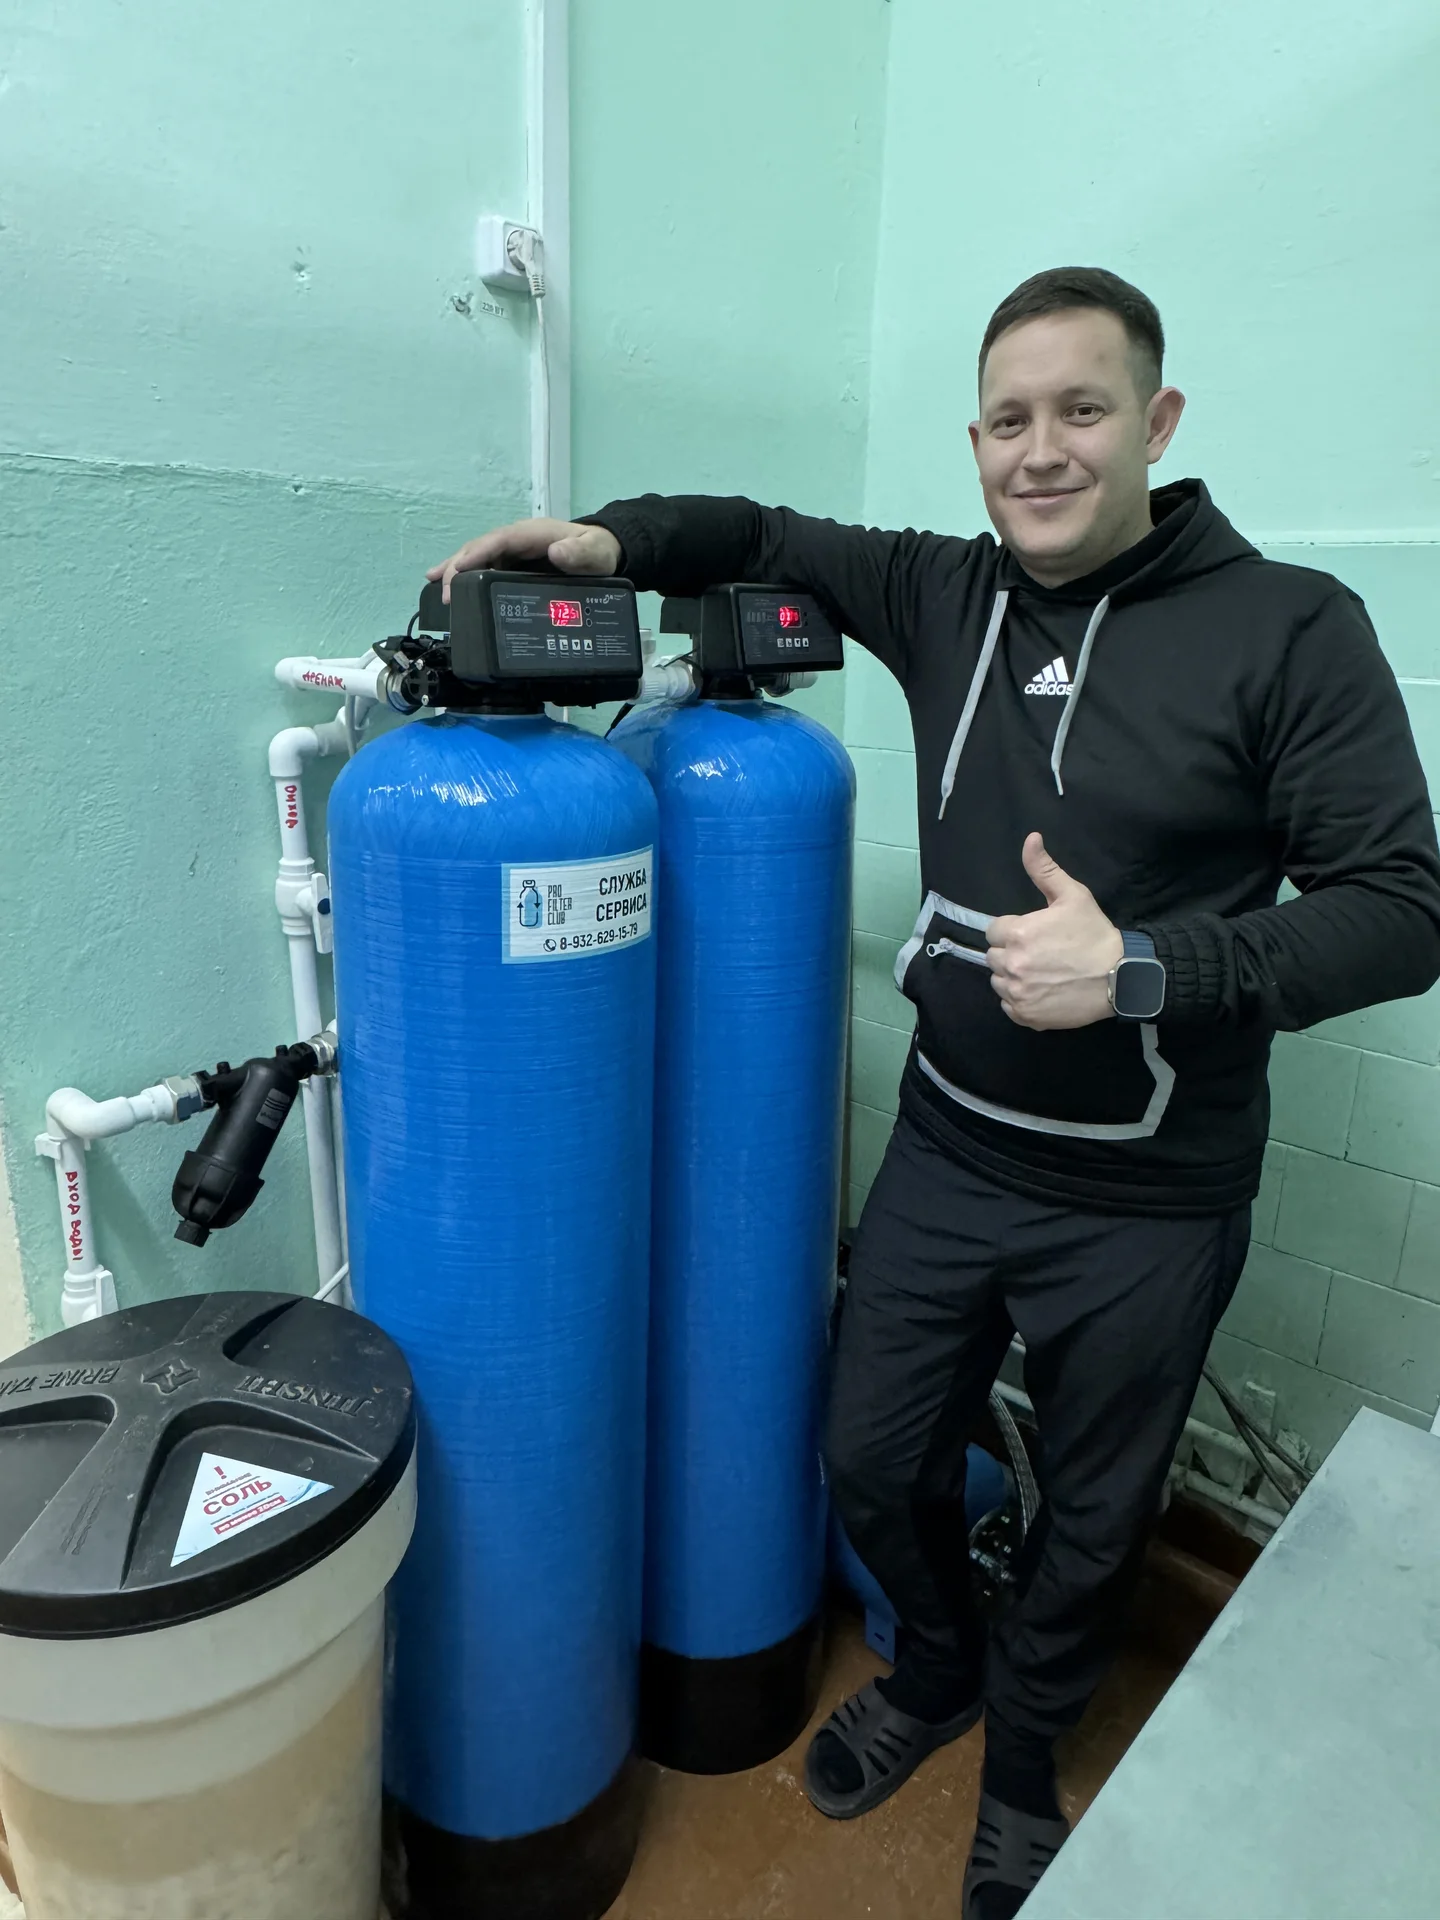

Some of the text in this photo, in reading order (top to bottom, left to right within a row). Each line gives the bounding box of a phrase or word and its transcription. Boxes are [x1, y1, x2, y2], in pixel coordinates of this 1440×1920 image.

[1024, 681, 1074, 696] adidas
[599, 868, 647, 896] СЛУЖБА
[547, 897, 573, 912] FILTER
[596, 893, 647, 922] СЕРВИСА
[547, 912, 566, 926] CLUB
[39, 1367, 120, 1389] BRINE
[203, 1480, 273, 1515] СОЛЬ
